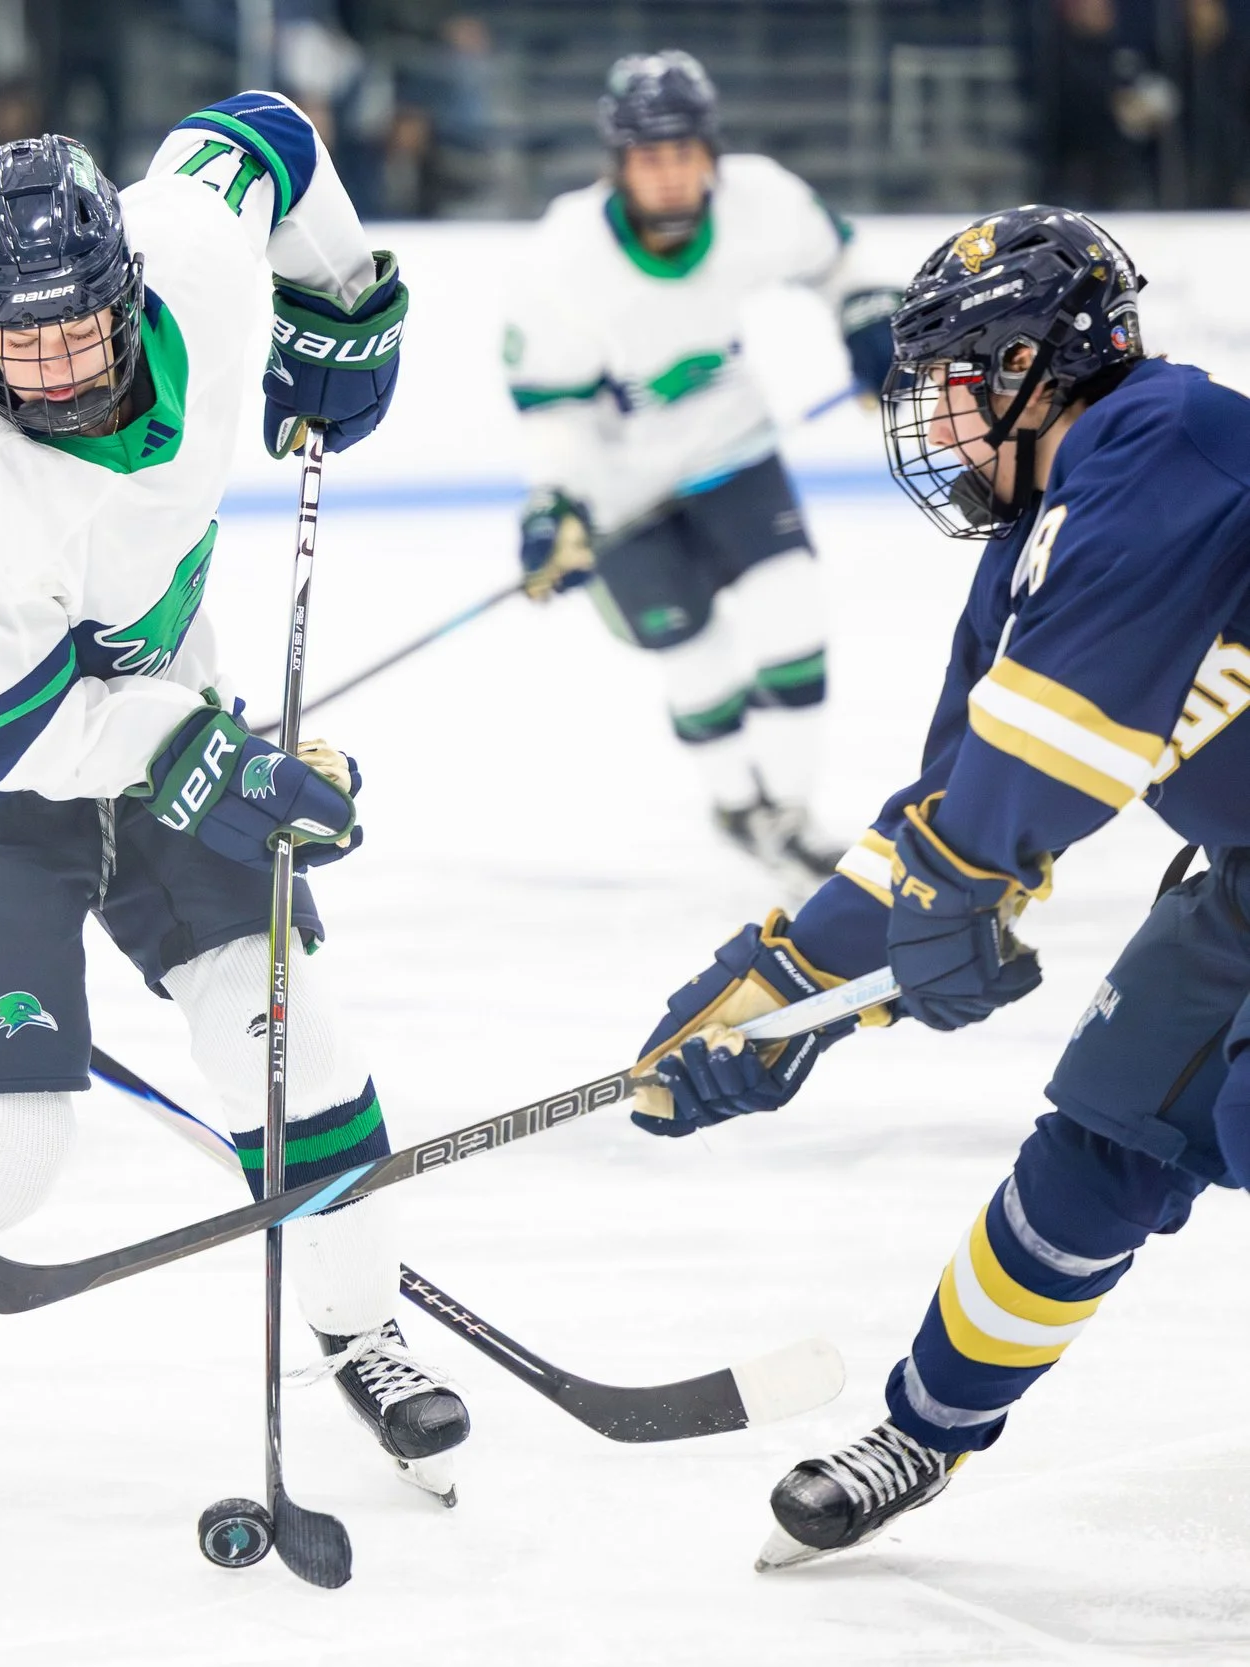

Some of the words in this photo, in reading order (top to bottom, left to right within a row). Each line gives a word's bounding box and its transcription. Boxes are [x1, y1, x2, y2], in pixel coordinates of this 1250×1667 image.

[11, 284, 76, 304] BAUER
[271, 314, 410, 363] BAUE
[292, 647, 301, 671] FLEX
[157, 728, 237, 832] UER
[773, 949, 817, 994] BAUER
[401, 1270, 489, 1336] YLITE
